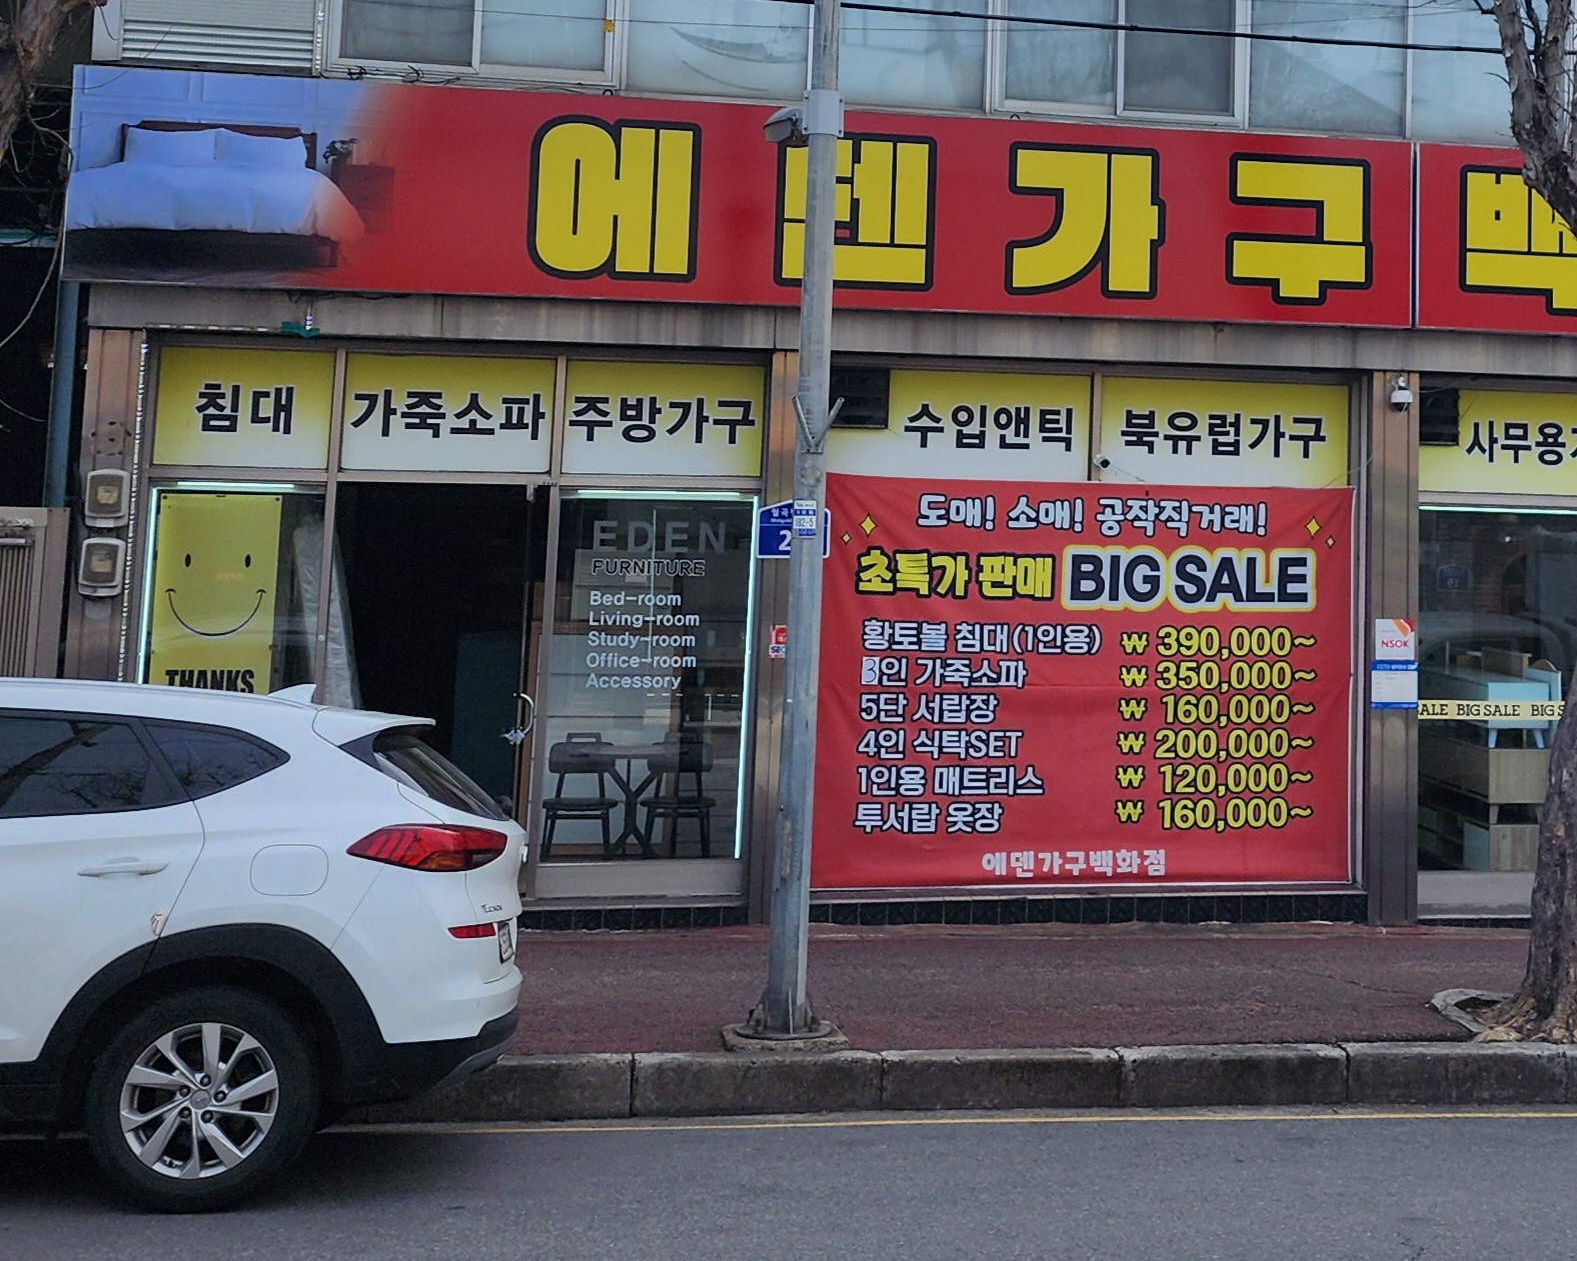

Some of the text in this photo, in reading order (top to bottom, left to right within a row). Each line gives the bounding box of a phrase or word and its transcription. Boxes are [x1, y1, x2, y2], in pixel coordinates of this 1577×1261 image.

[195, 383, 294, 435] 침대
[350, 389, 546, 441] 가죽소파
[568, 394, 756, 445] 주방가구
[903, 402, 1075, 453] 수입앤틱
[1120, 409, 1327, 459] 북유럽가구
[917, 494, 996, 530] 도매!
[1006, 496, 1084, 533] 소매!
[592, 520, 727, 554] EDEN
[778, 529, 792, 551] 2
[591, 558, 706, 576] FURNITURE
[857, 549, 1310, 604] 초특가 판매 BIG SALE
[590, 590, 682, 607] Bed-room
[588, 611, 700, 627] Living-room
[587, 631, 696, 649] Study-room
[862, 619, 948, 652] 황토볼
[954, 622, 1103, 655] 침대(1인용)
[1380, 639, 1410, 649] NSOK
[586, 653, 697, 668] Office-room
[861, 656, 908, 687] 3인
[915, 657, 1028, 688] 가죽소파
[165, 669, 255, 694] THANKS
[585, 673, 682, 690] Accessory
[860, 693, 907, 723] 5단
[912, 693, 999, 724] 서랍장
[1418, 704, 1449, 715] ALE
[1456, 704, 1481, 716] BIG
[1483, 705, 1521, 716] SALE
[1530, 705, 1555, 717] BIG
[857, 729, 905, 760] 4인
[912, 730, 1023, 760] 식탁SET
[857, 765, 927, 796] 1인용
[933, 765, 1045, 796] 매트리스
[854, 801, 941, 833] 투서랍
[946, 801, 1004, 833] 옷장
[981, 849, 1166, 878] 에덴가구백화점
